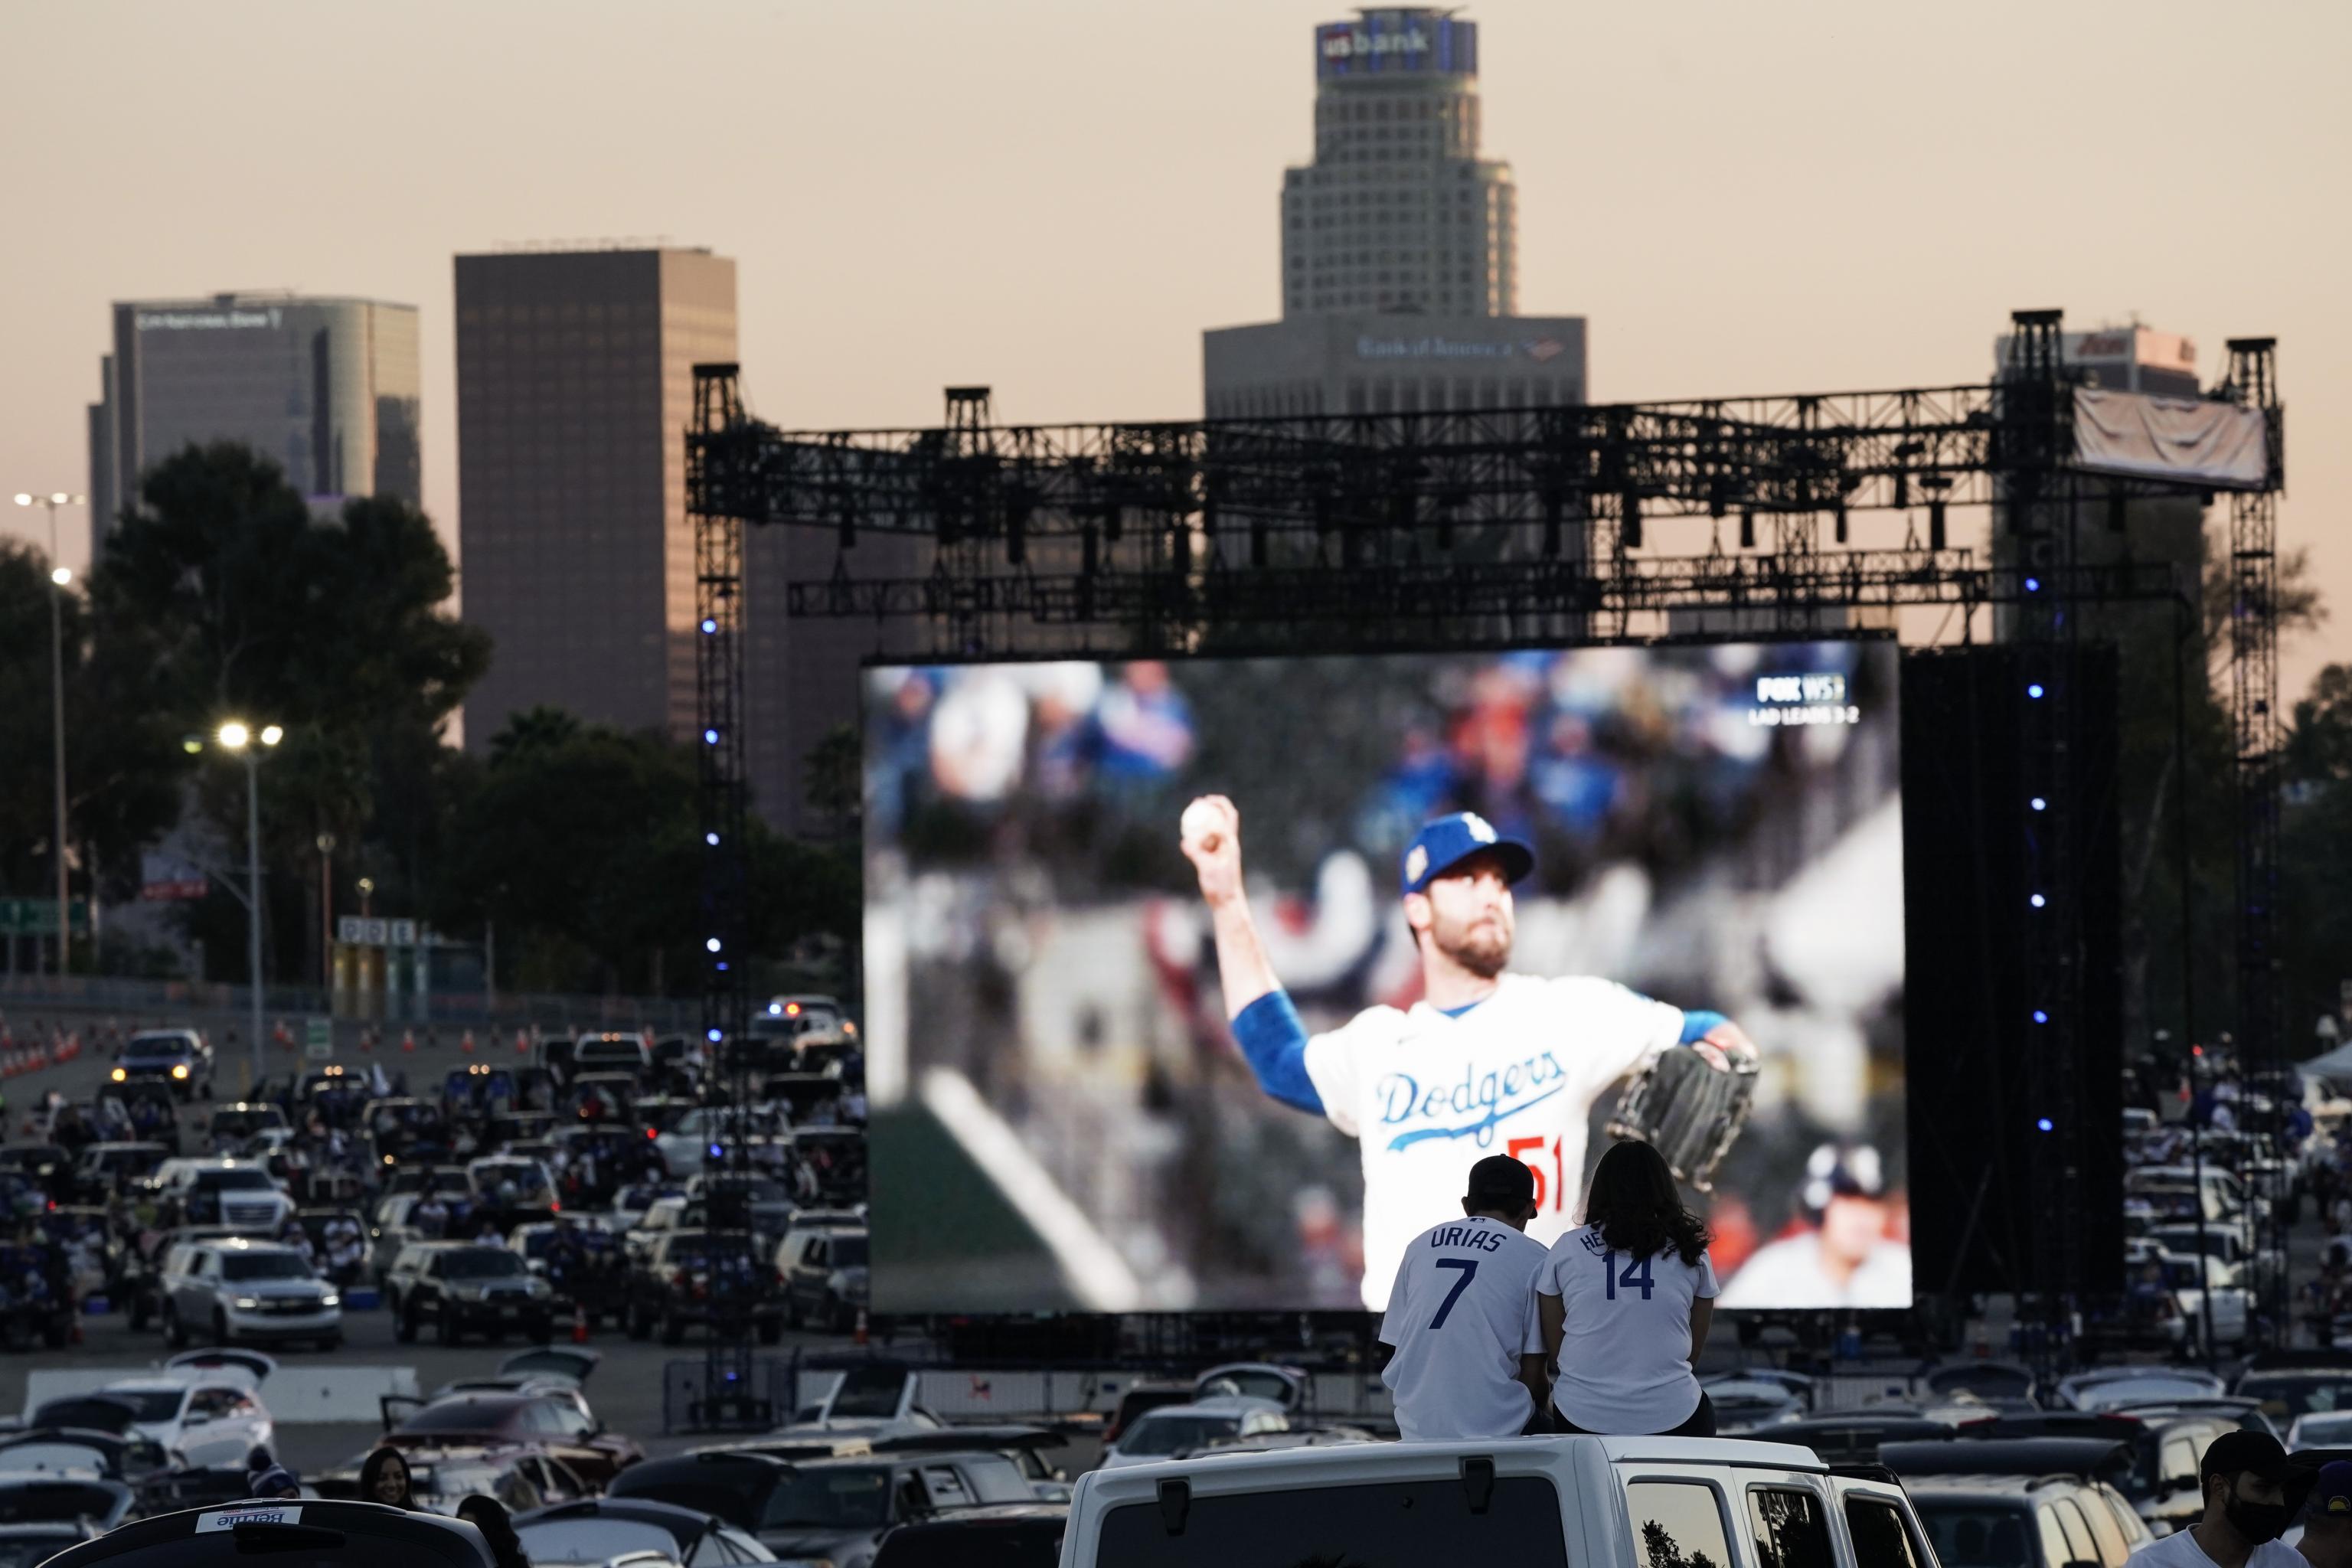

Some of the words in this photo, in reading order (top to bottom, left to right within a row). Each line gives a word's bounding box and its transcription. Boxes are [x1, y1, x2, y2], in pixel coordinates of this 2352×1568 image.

[1757, 677, 1801, 702] FOX
[1377, 1051, 1566, 1148] Dodgers
[1508, 1135, 1562, 1212] 51
[1431, 1227, 1507, 1252] URIAS
[1429, 1258, 1479, 1329] 7
[1602, 1250, 1655, 1300] 14
[217, 1513, 285, 1527] Bernie
